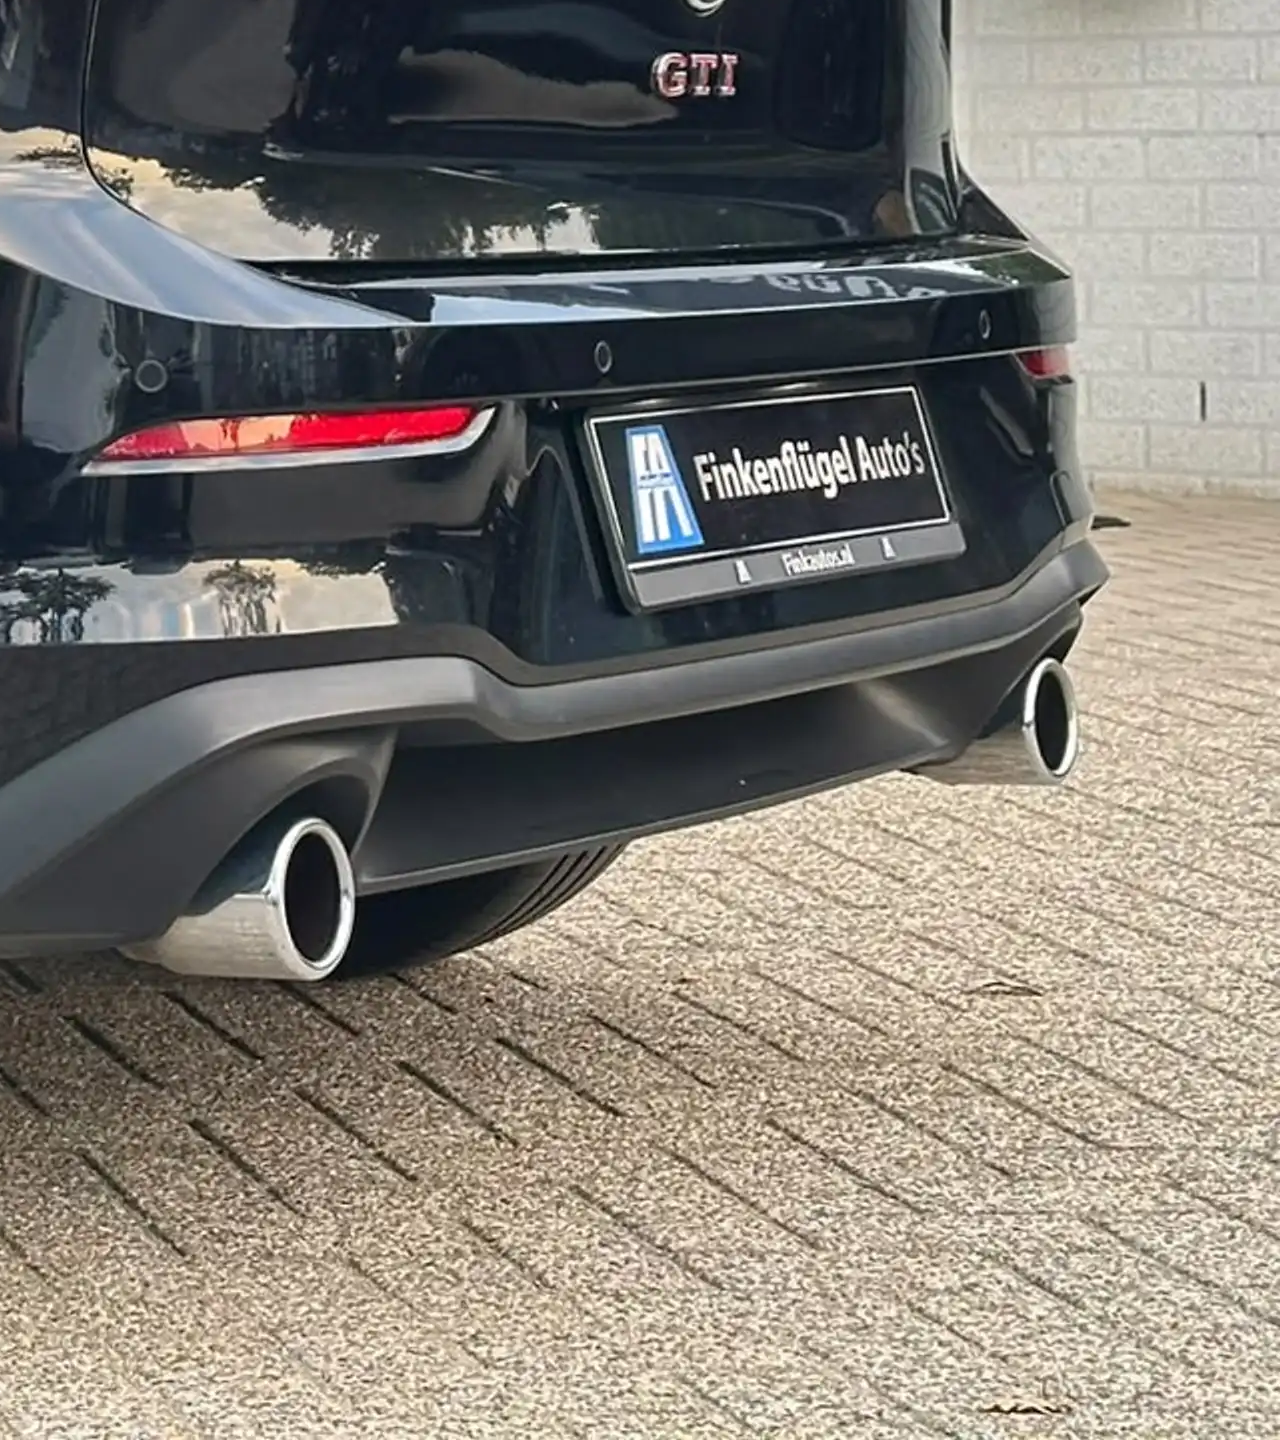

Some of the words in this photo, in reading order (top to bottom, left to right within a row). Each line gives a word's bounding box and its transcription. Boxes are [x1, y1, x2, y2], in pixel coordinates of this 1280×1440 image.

[650, 51, 740, 98] GTI
[692, 434, 858, 502] Finkenflügel
[855, 431, 926, 482] Auto's
